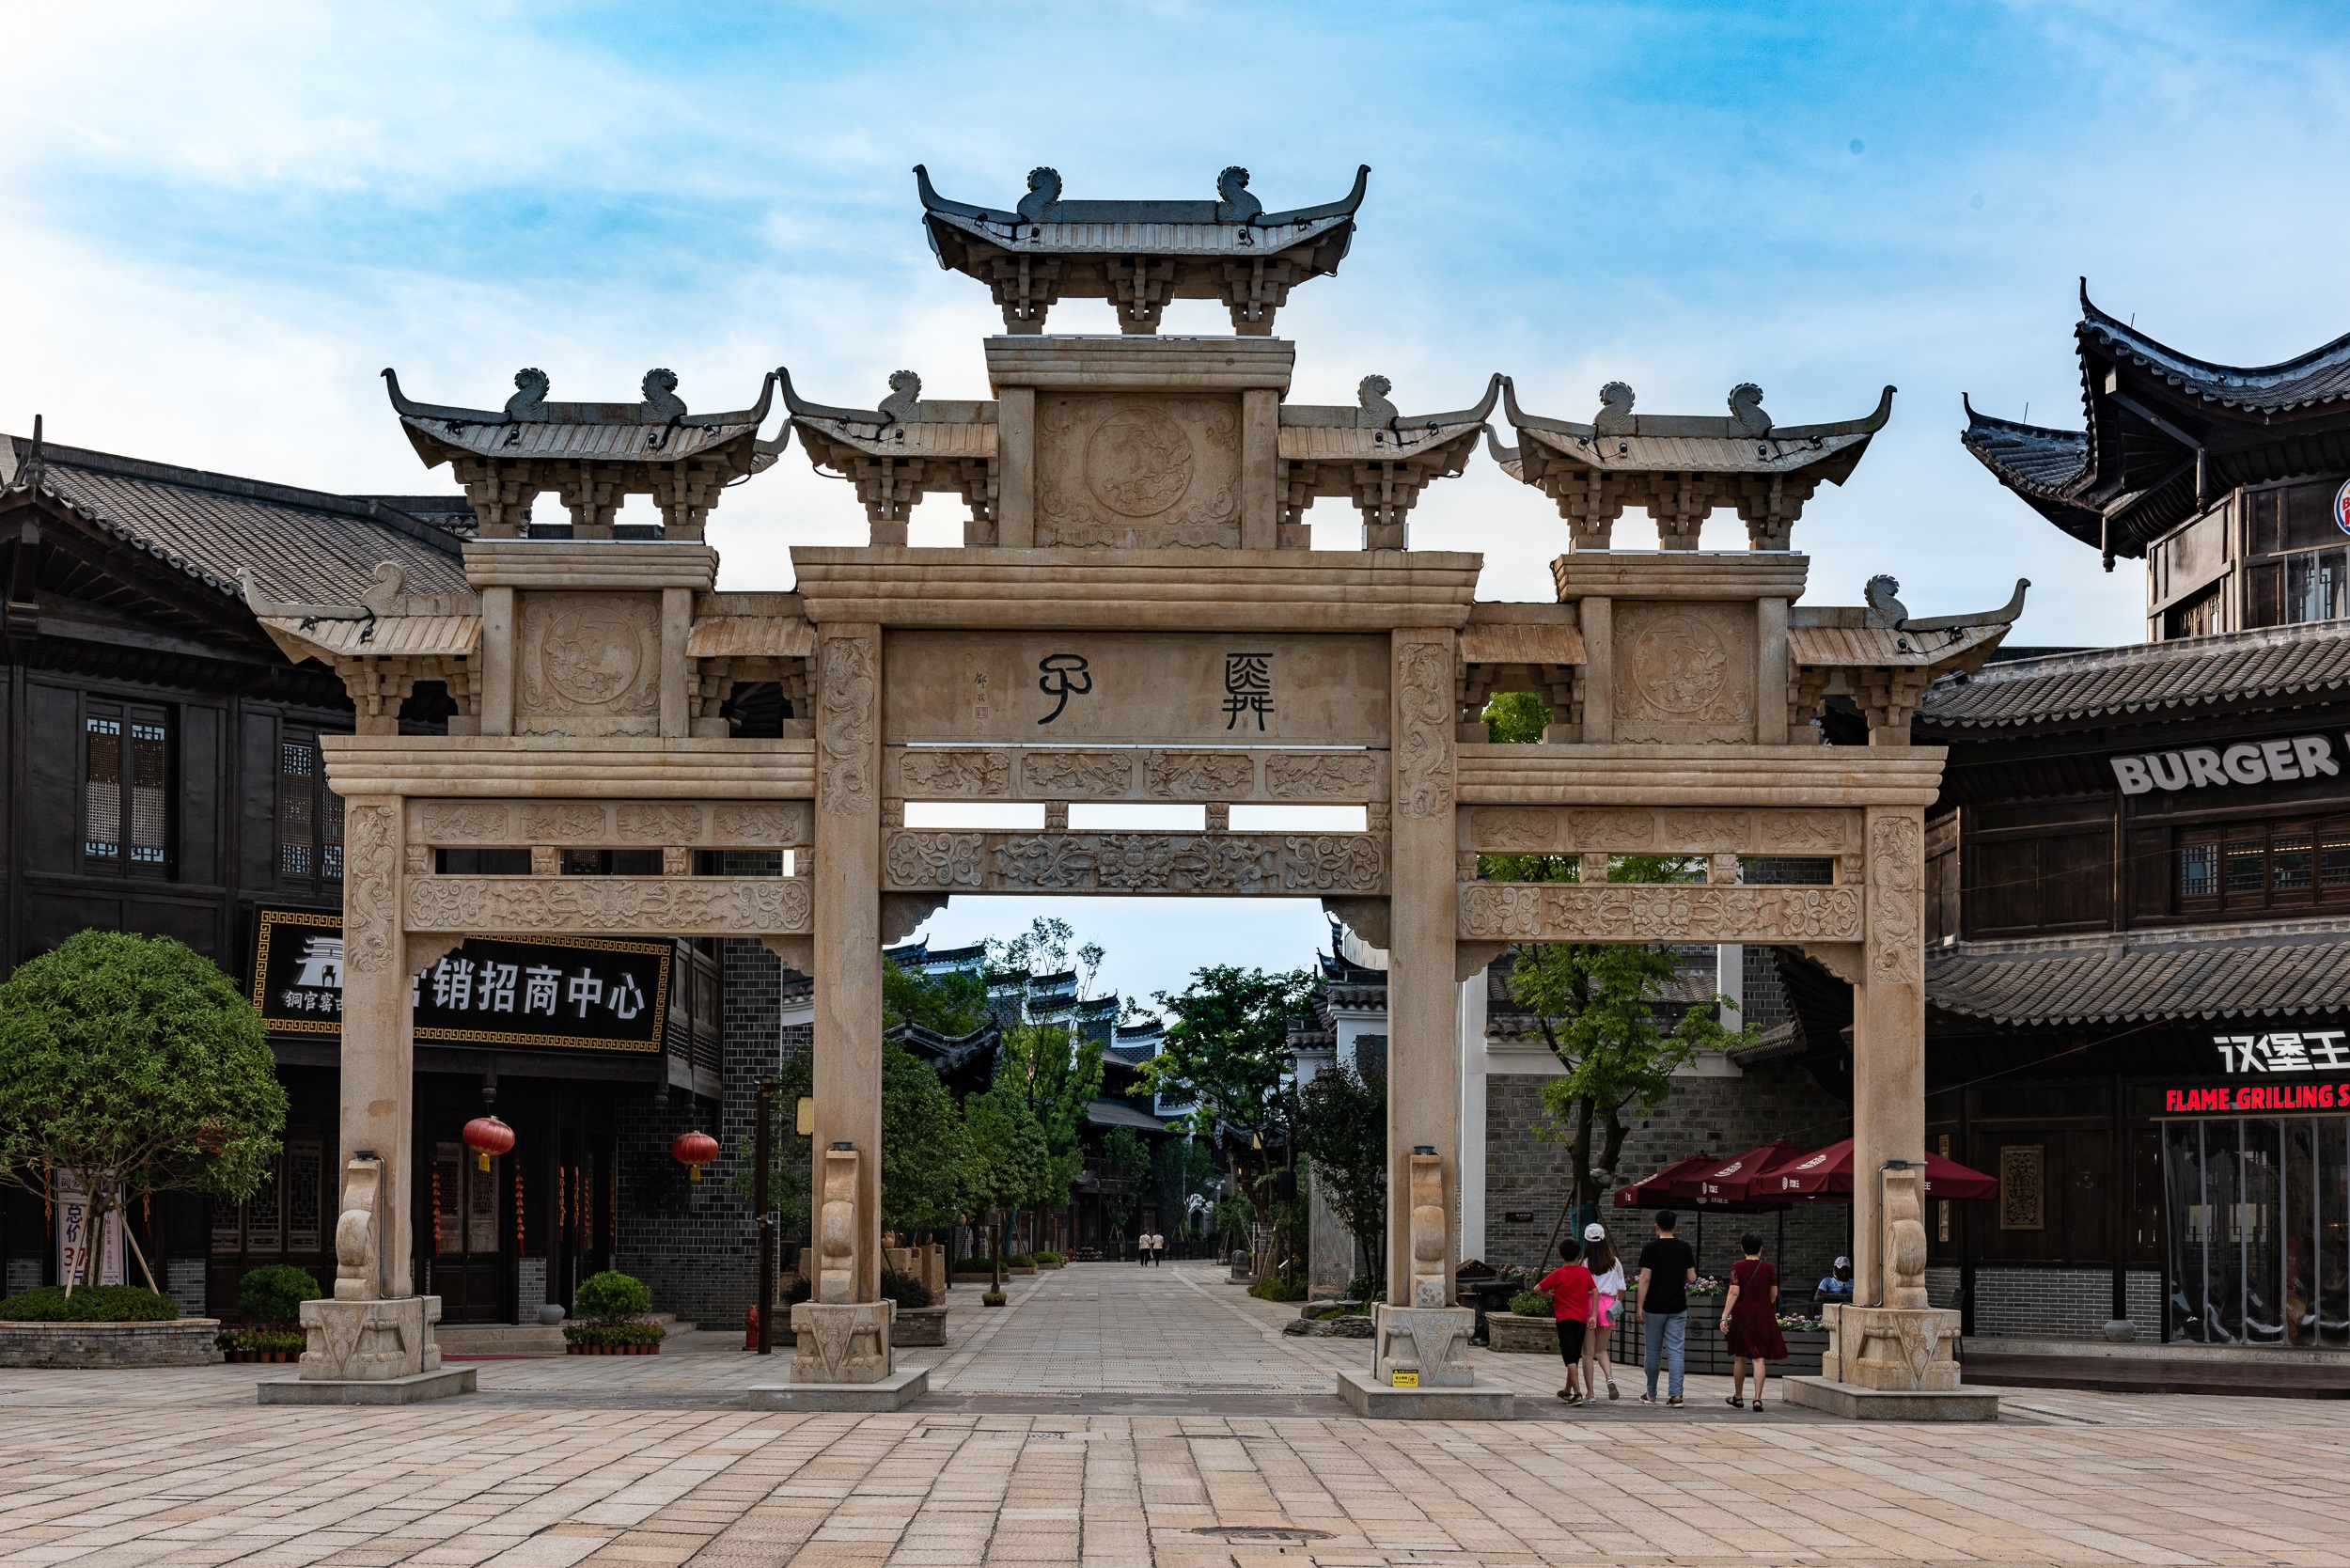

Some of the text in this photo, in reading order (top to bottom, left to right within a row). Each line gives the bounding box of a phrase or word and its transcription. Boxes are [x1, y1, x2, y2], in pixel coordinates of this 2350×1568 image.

[2109, 735, 2341, 795] BURGER
[2213, 1030, 2350, 1074] 汉堡王
[2166, 1088, 2231, 1112] FLAME
[2236, 1084, 2334, 1109] GRILLING
